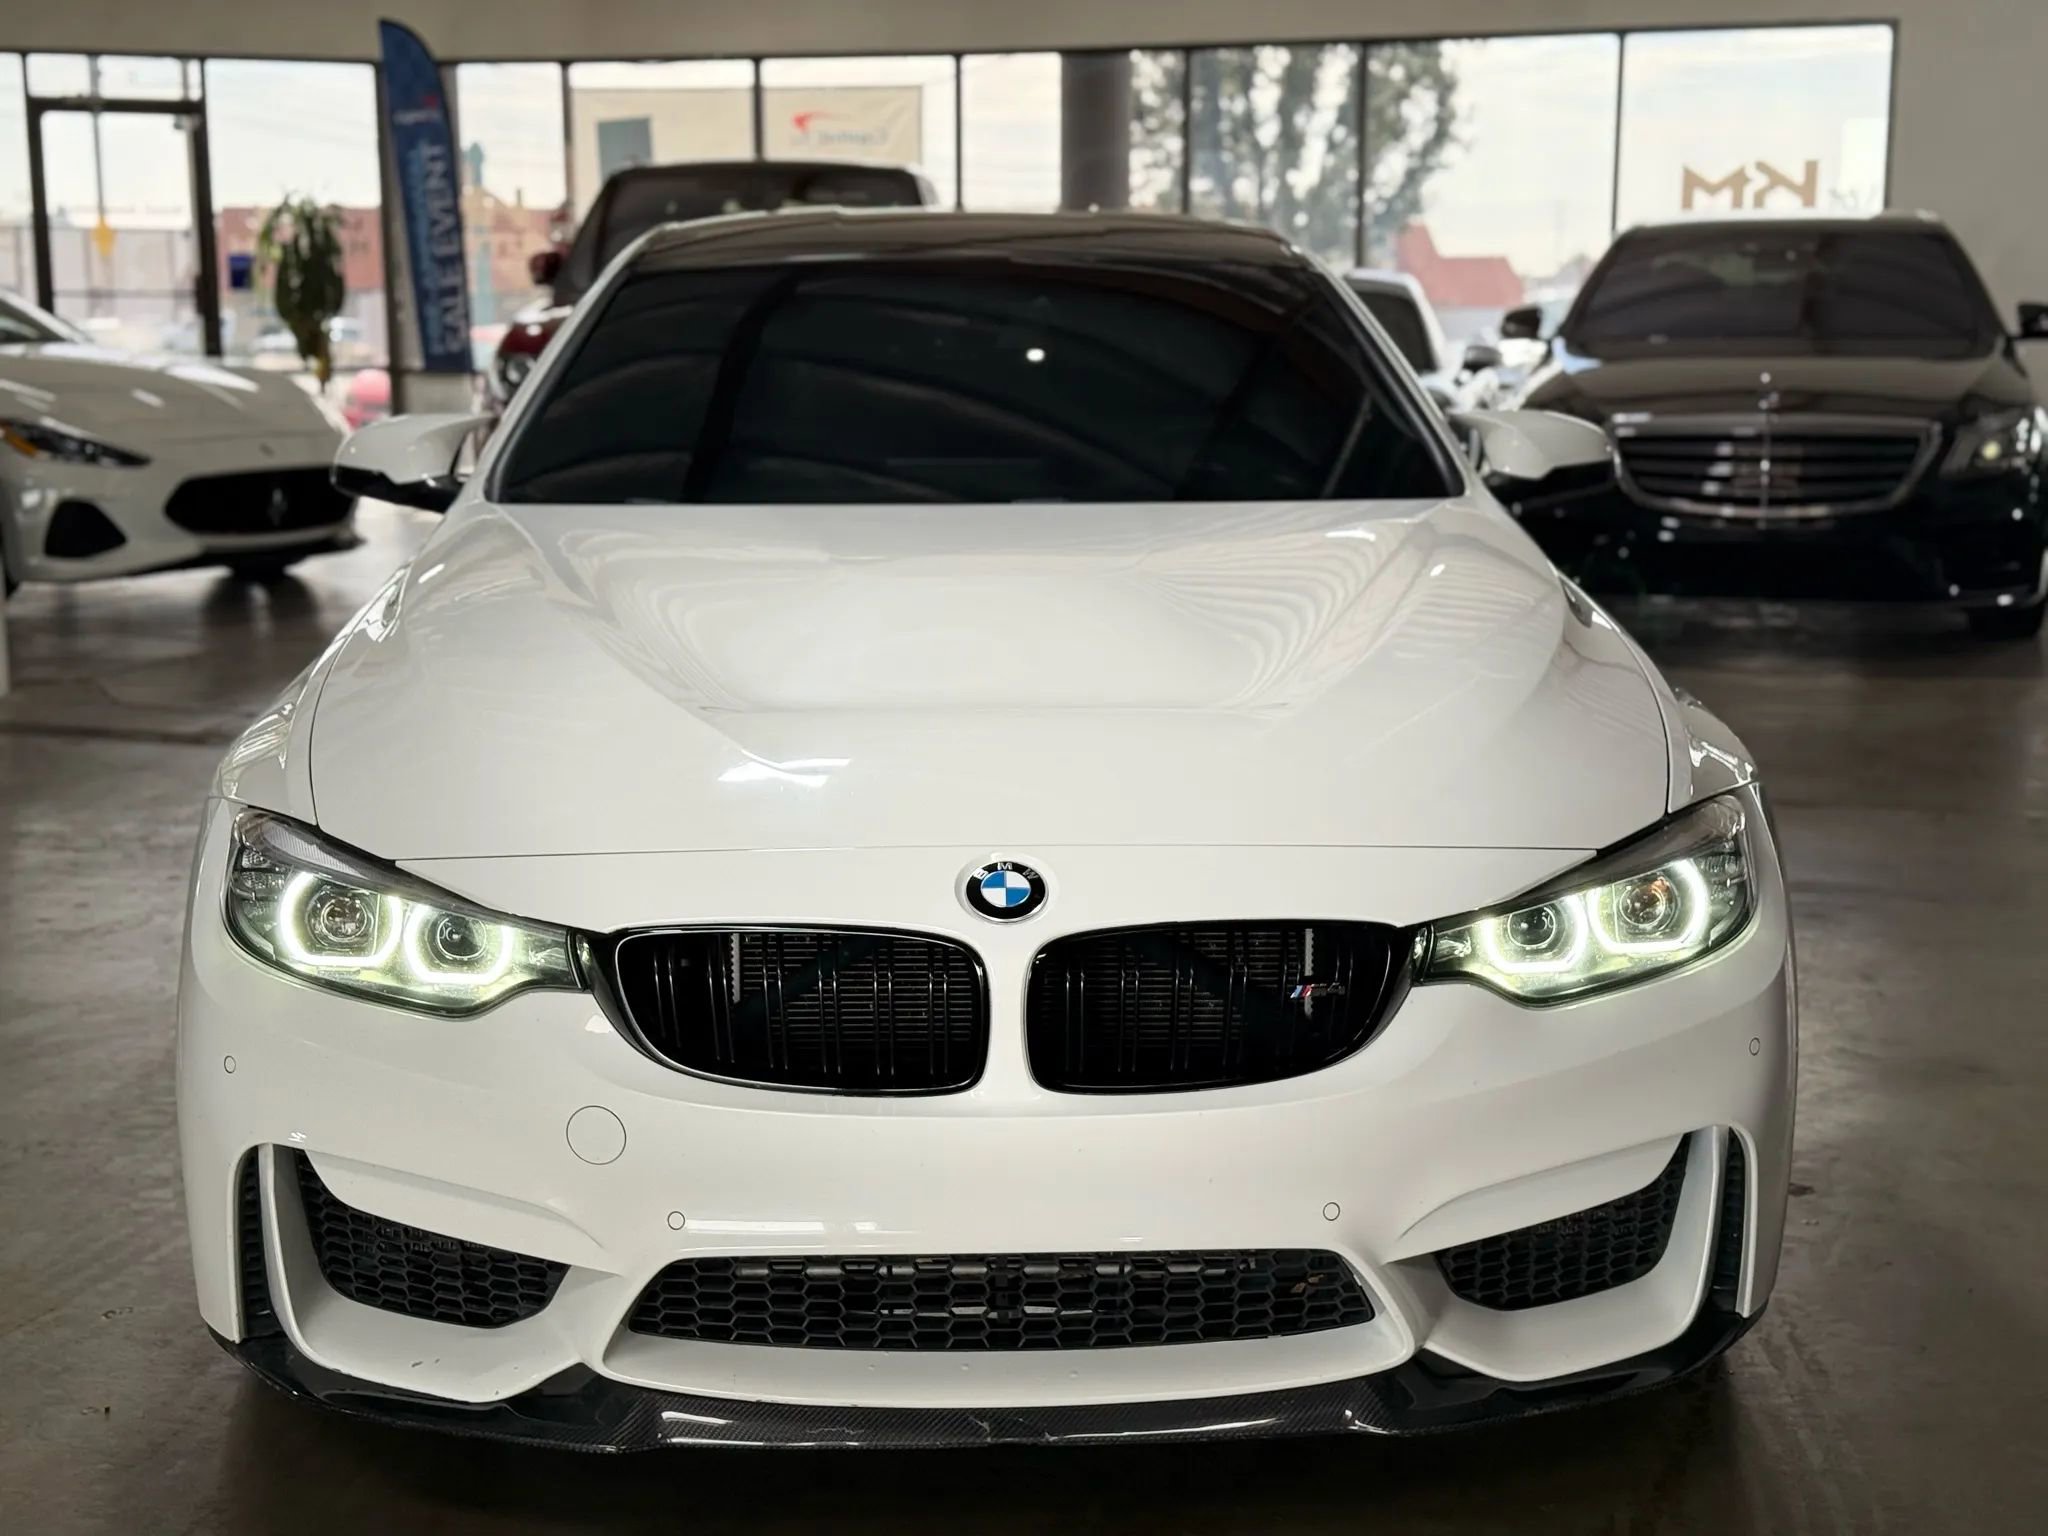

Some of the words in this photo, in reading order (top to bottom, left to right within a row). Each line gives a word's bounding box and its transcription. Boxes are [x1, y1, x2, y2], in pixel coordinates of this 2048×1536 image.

[423, 143, 460, 258] EVENT
[434, 261, 469, 353] SALE
[972, 861, 1040, 880] BMW
